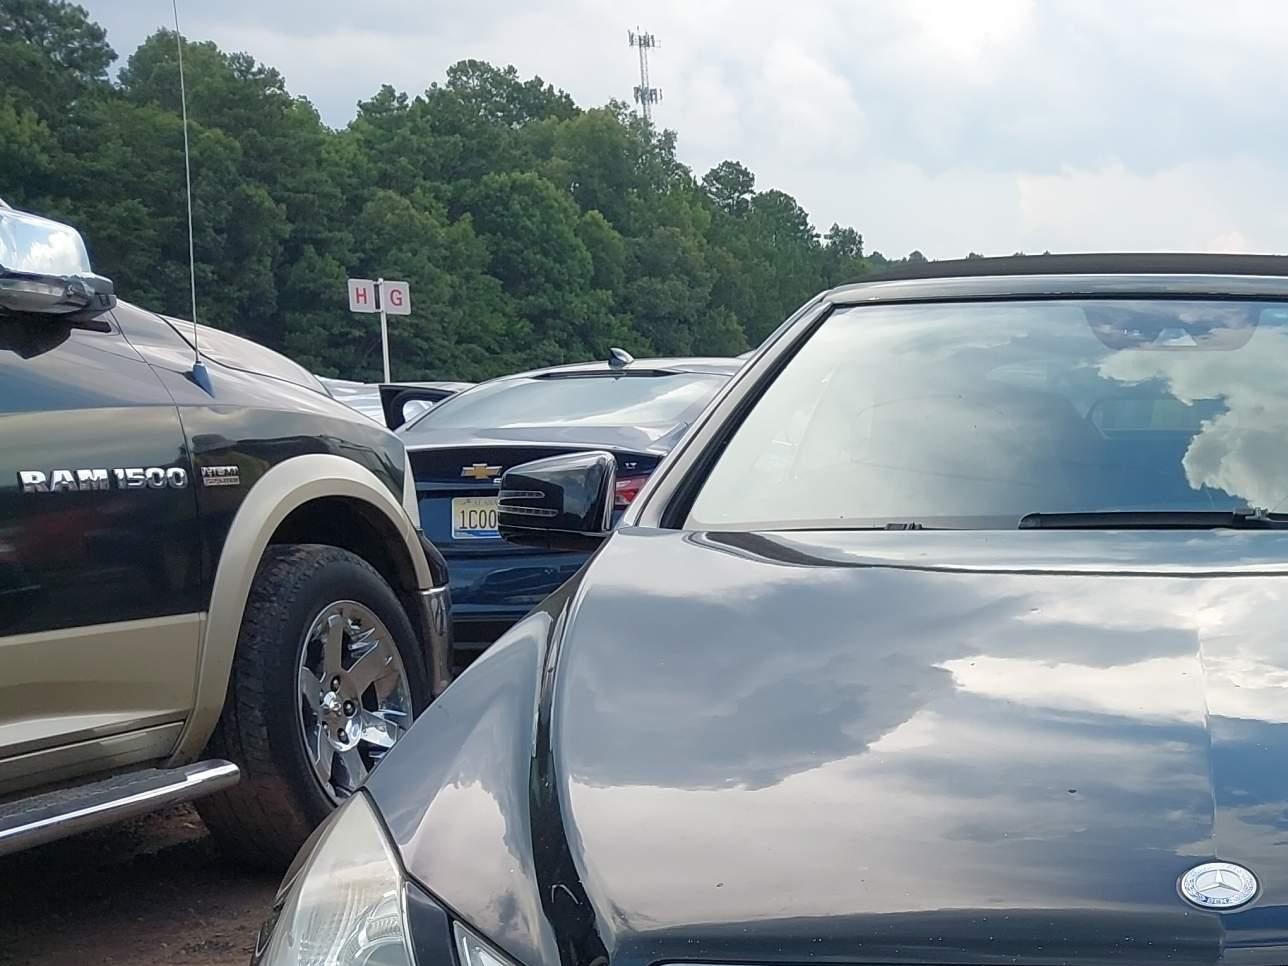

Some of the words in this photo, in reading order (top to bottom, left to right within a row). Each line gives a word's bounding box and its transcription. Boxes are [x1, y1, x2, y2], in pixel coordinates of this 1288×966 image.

[355, 287, 368, 305] H
[390, 289, 403, 306] G
[17, 469, 110, 493] RAM
[111, 467, 188, 489] 1500
